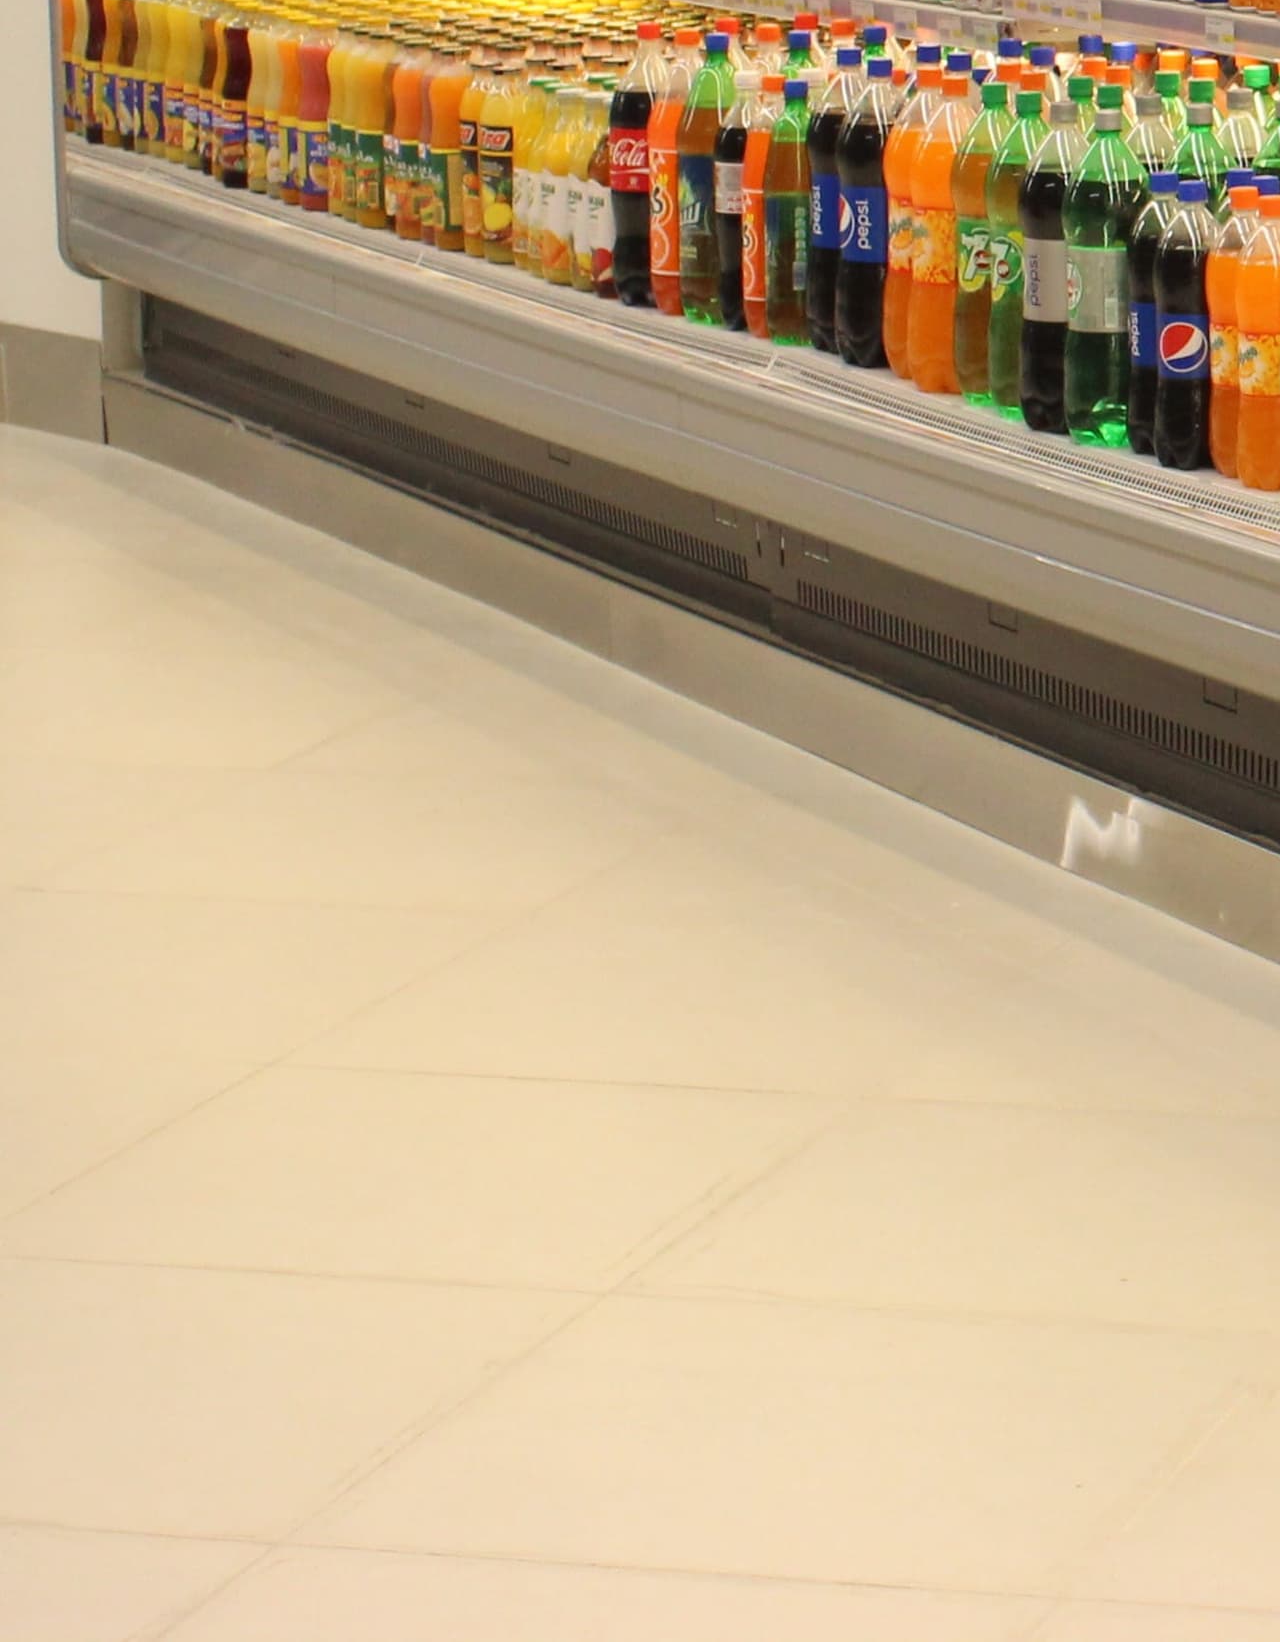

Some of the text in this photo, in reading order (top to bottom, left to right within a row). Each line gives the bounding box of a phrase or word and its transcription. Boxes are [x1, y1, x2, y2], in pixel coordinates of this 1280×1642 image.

[810, 184, 822, 236] pepsi
[855, 198, 872, 251] pepsi
[1029, 252, 1042, 307] pepsi
[1130, 311, 1141, 357] pepsi
